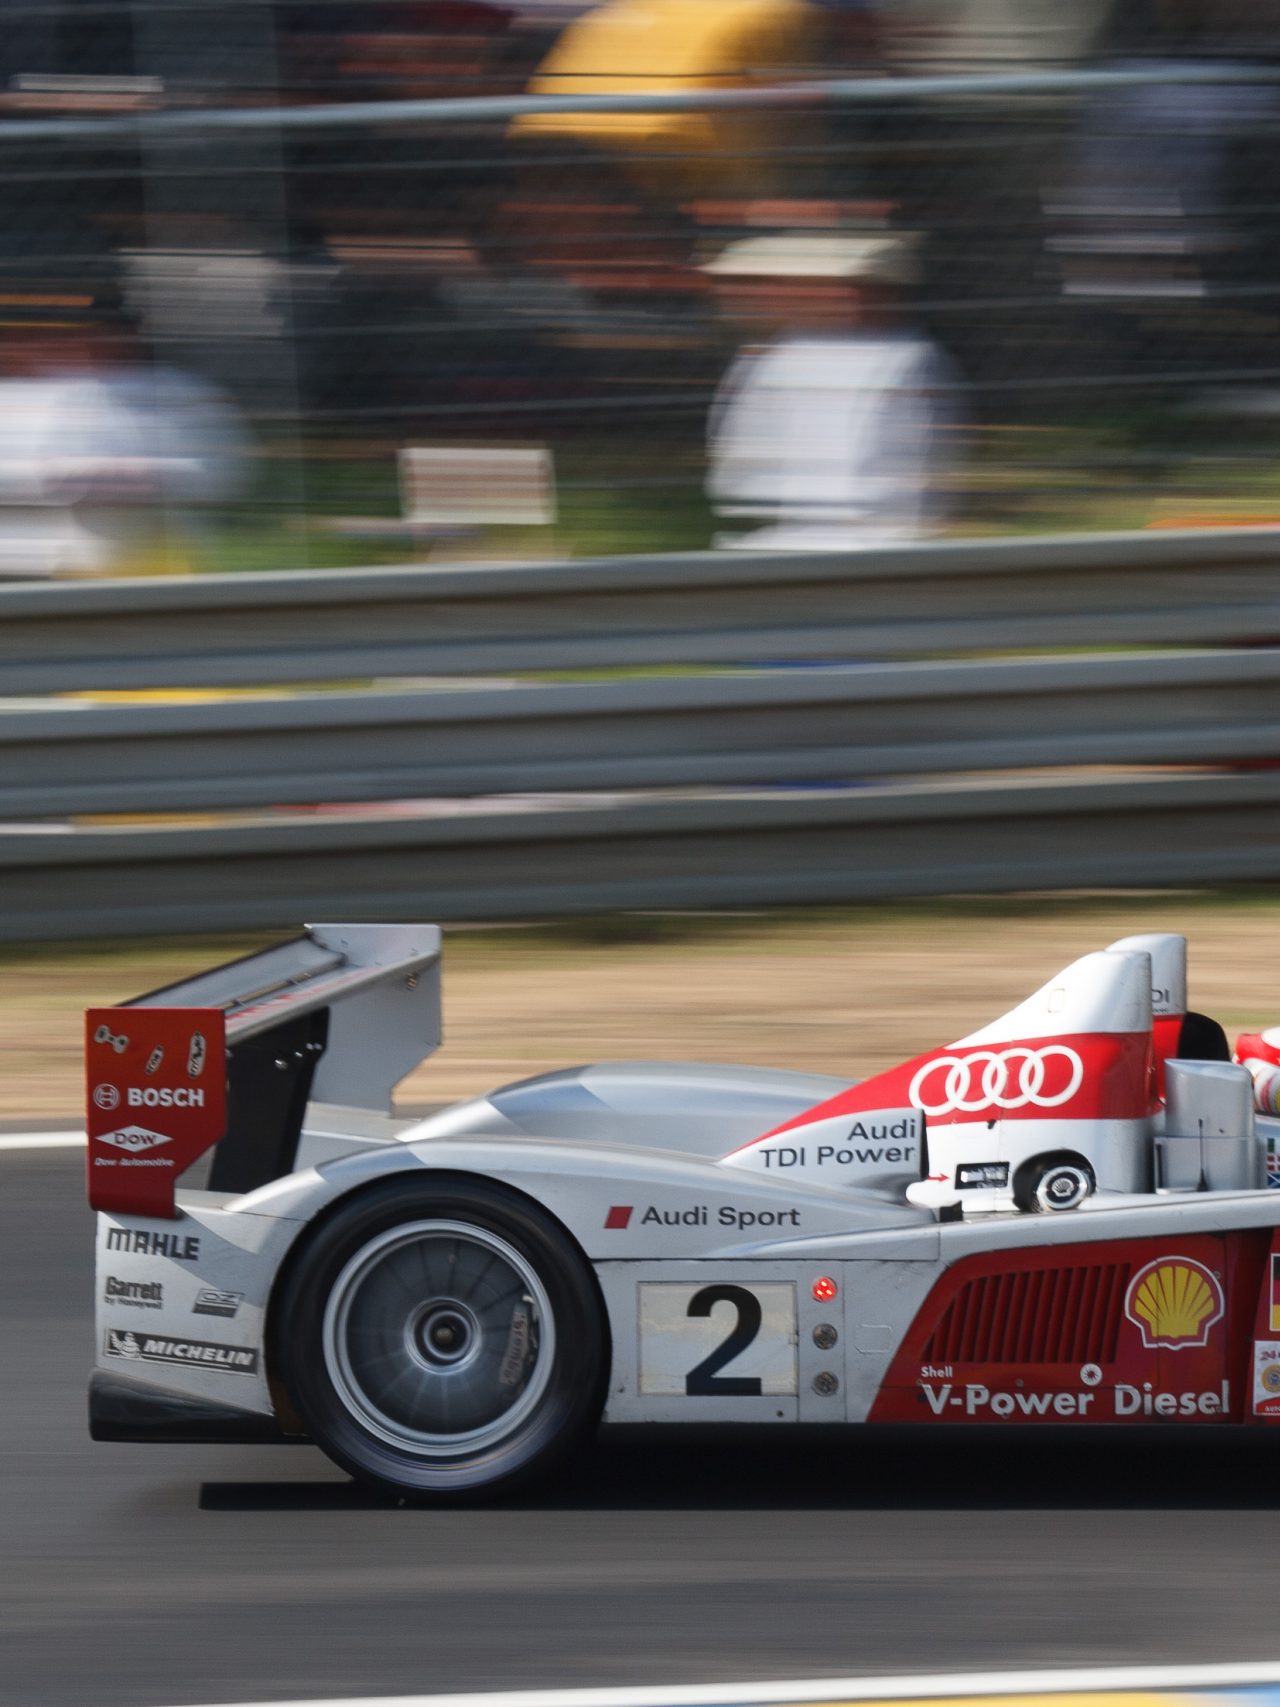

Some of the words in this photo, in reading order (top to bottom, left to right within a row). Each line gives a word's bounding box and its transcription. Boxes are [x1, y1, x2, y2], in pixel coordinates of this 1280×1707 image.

[1152, 989, 1169, 1003] DI
[127, 1087, 205, 1107] BOSCH
[847, 1118, 915, 1141] Audi
[119, 1157, 175, 1167] Automotive
[759, 1148, 805, 1168] TDI
[817, 1144, 915, 1166] Power
[641, 1206, 708, 1226] Audi
[718, 1206, 801, 1230] Sport
[107, 1227, 201, 1261] MAHLE
[106, 1276, 162, 1301] Garrett
[686, 1284, 762, 1396] 2
[143, 1339, 255, 1366] MICHELIN
[921, 1366, 953, 1378] Shell
[921, 1384, 1095, 1415] V-Power
[1114, 1379, 1230, 1415] Diesel
